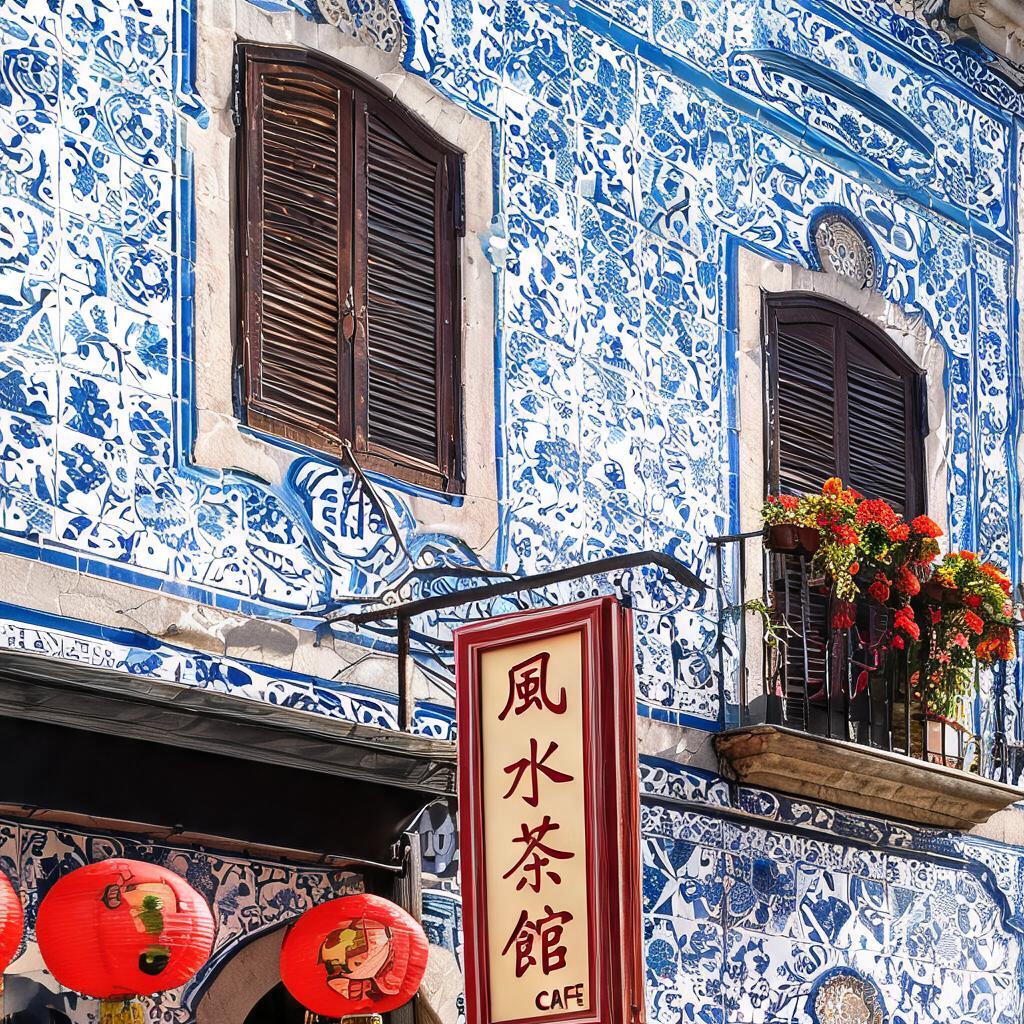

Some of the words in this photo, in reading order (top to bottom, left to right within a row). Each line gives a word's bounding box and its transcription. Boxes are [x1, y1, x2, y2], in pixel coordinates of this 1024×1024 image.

[498, 652, 575, 978] 風水茶館
[535, 983, 584, 1011] CAFE
